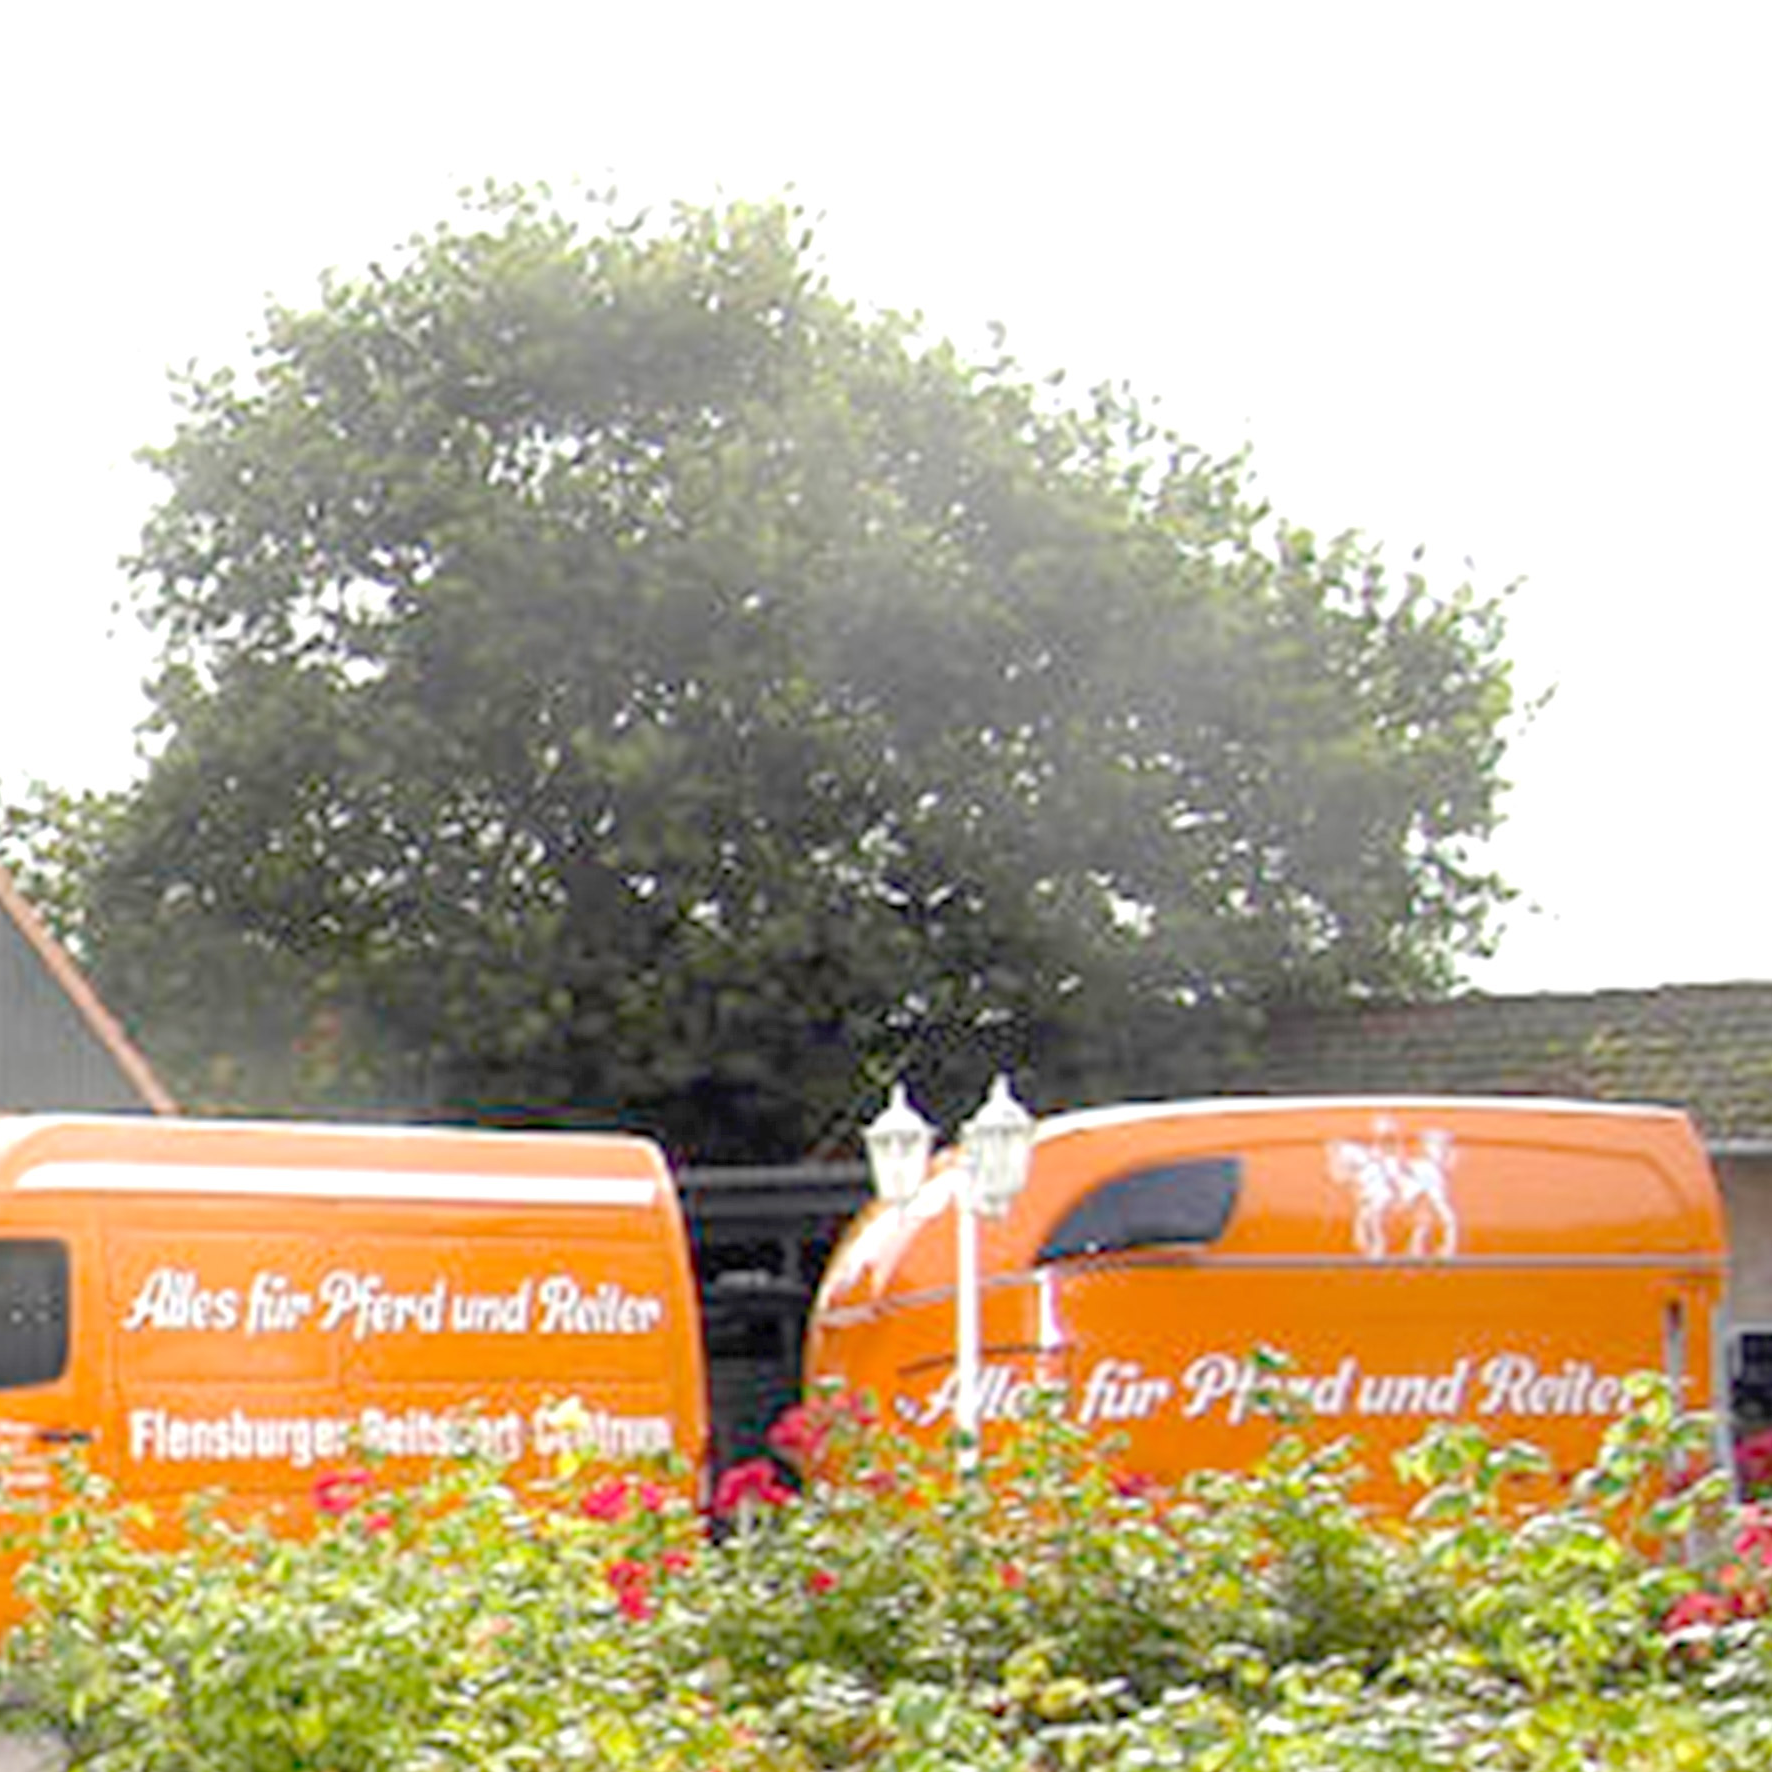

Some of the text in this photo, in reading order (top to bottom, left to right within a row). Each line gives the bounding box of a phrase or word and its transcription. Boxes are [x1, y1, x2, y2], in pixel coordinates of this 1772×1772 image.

[122, 1268, 663, 1341] Alles für Pferd und Reiter
[1076, 1357, 1174, 1425] für
[1358, 1357, 1471, 1417] und
[130, 1408, 350, 1468] Flensburger
